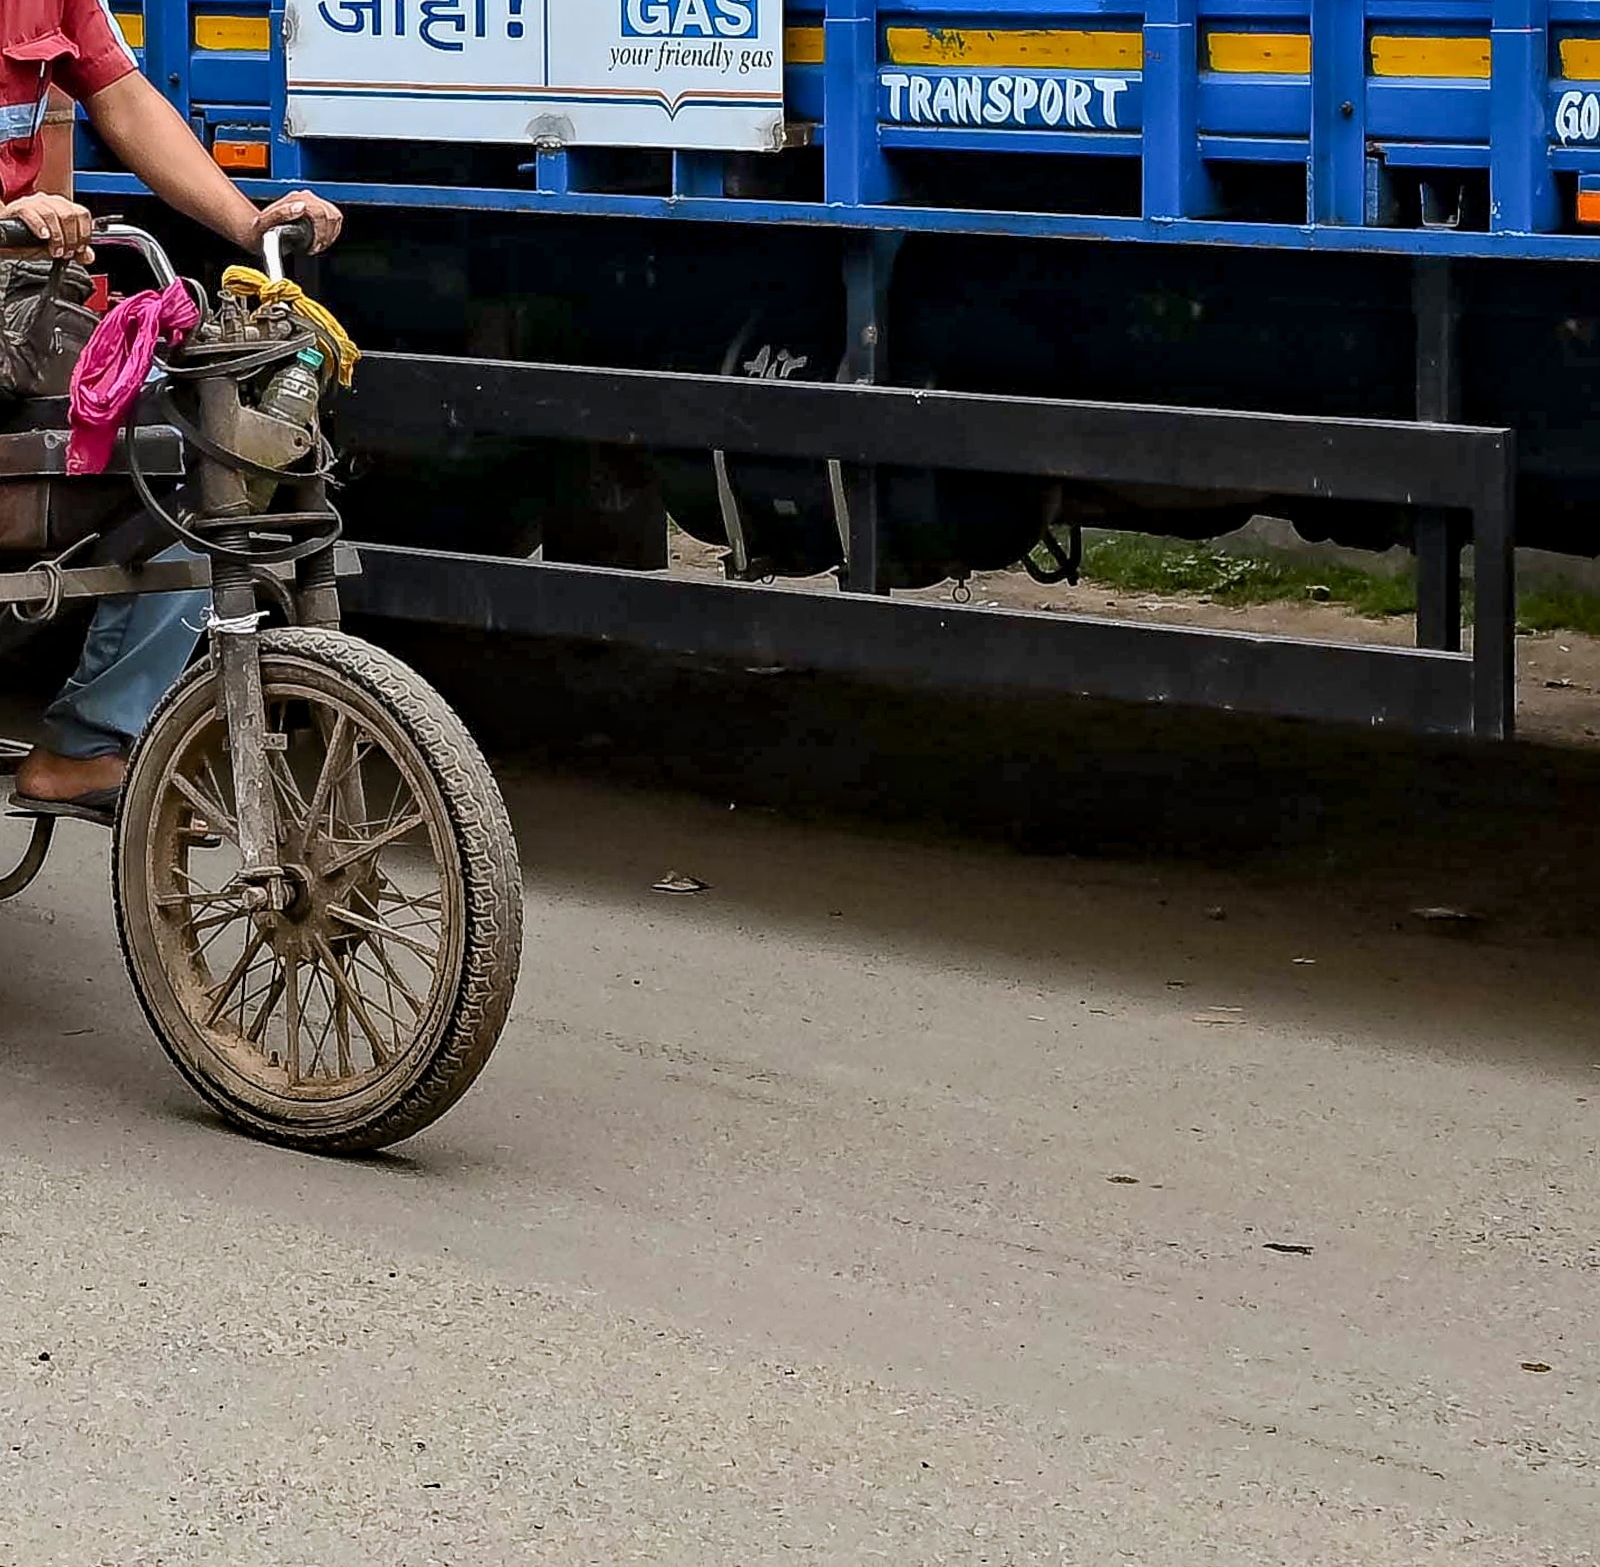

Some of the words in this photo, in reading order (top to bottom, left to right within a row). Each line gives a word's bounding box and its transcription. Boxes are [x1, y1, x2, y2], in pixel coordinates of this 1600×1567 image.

[608, 45, 654, 73] your
[654, 39, 737, 73] friendly
[738, 45, 774, 75] gas
[880, 73, 1129, 128] TRANSPORT
